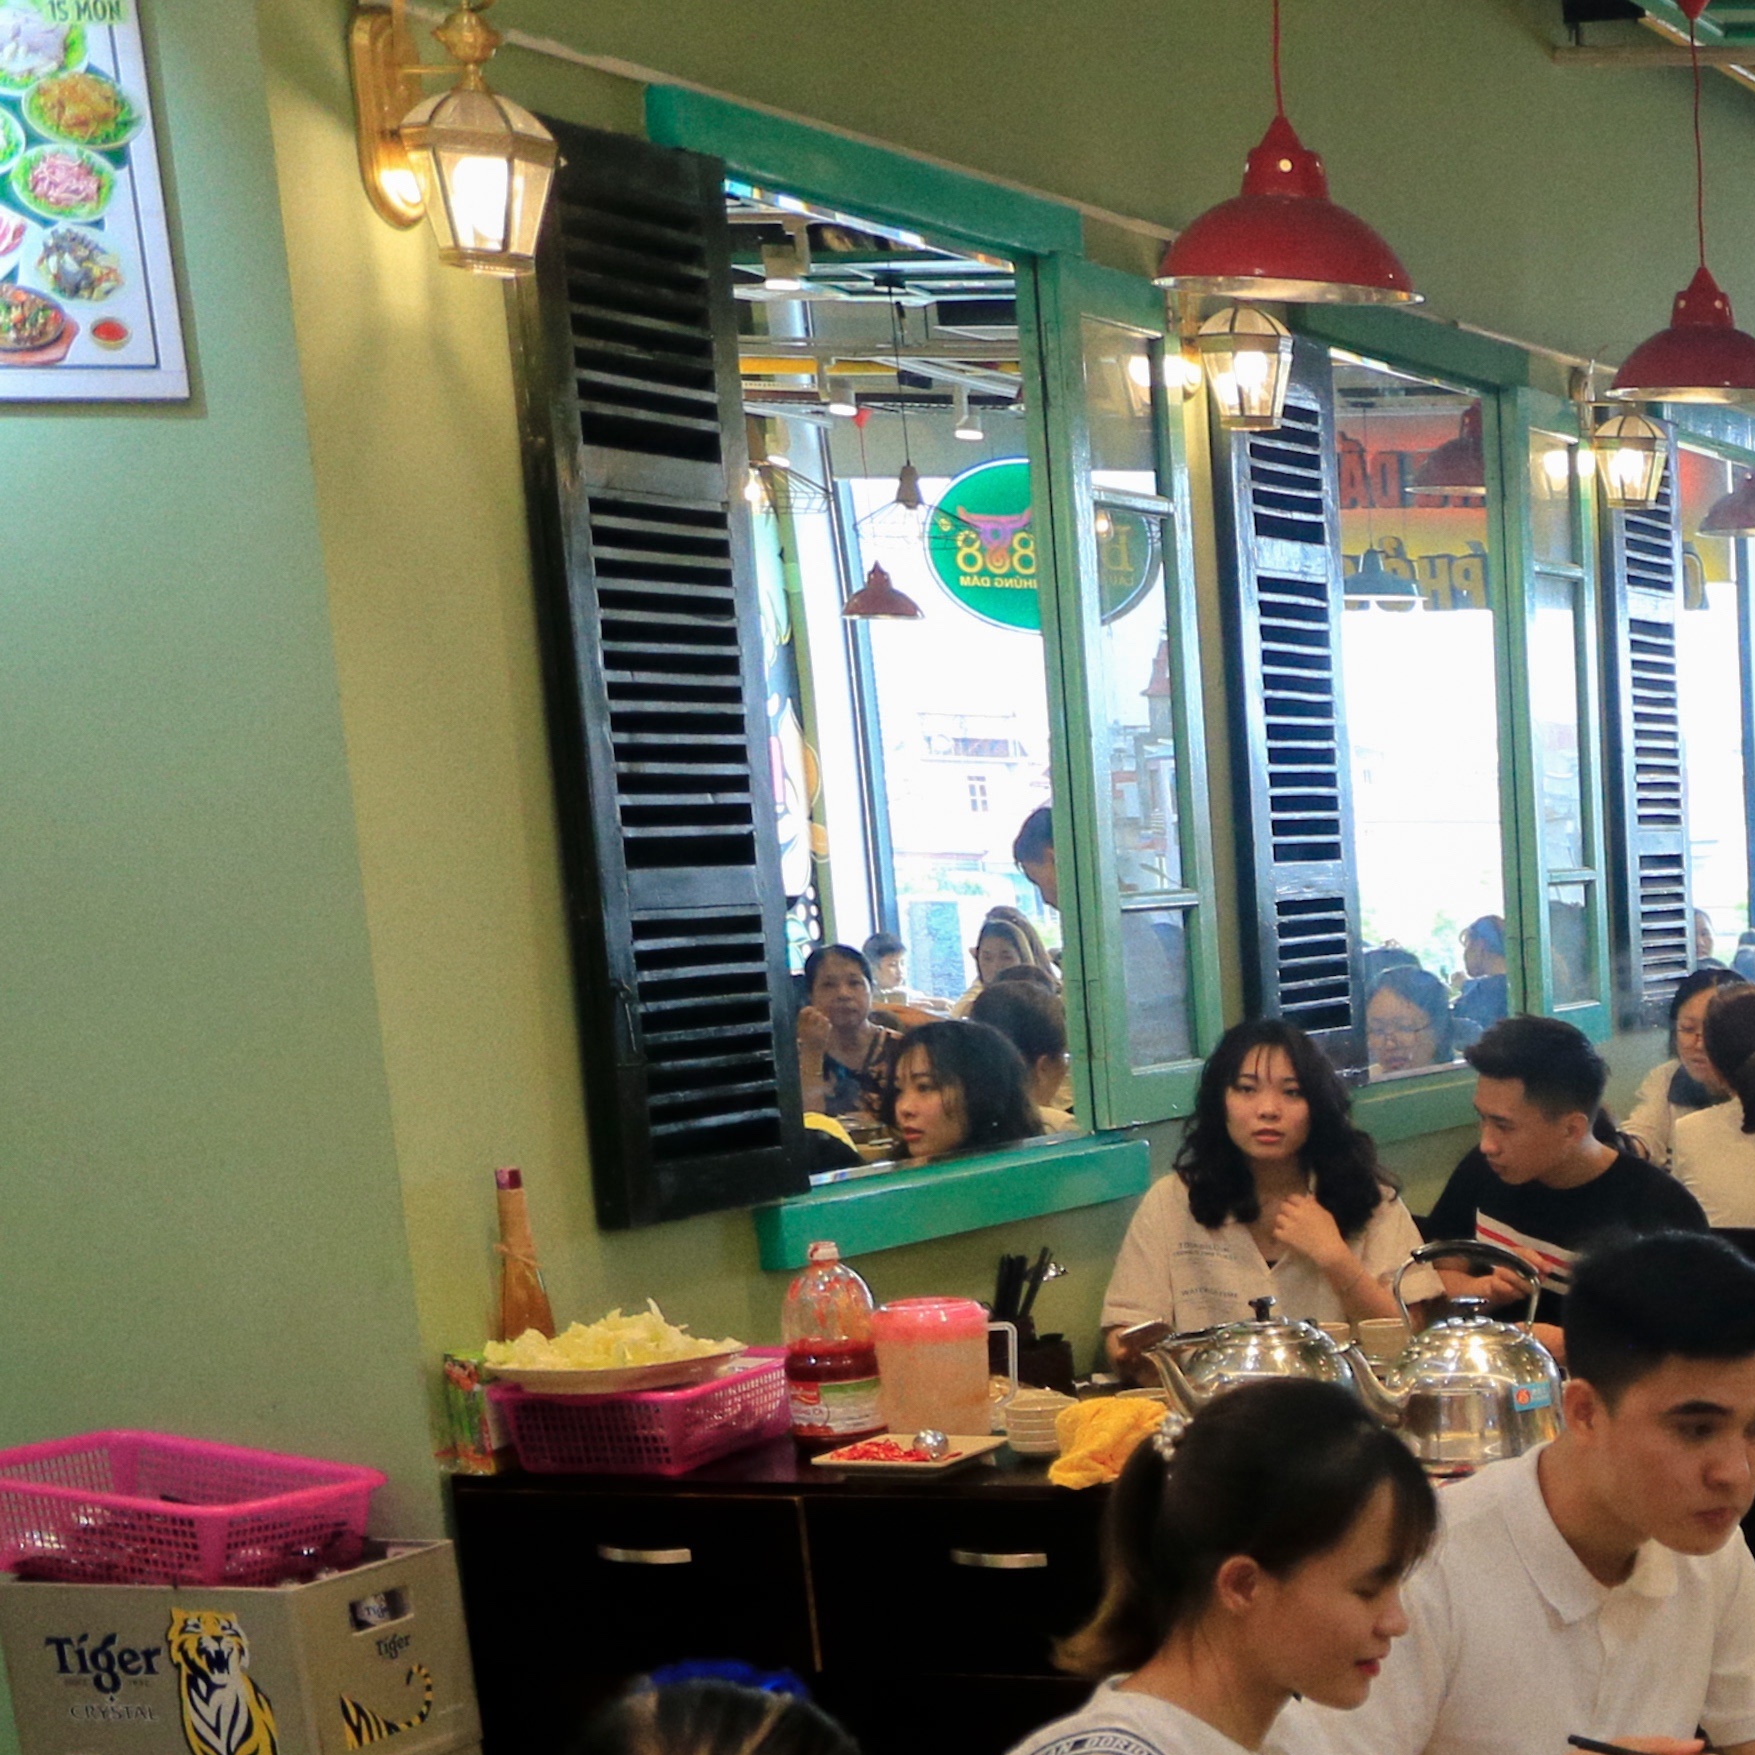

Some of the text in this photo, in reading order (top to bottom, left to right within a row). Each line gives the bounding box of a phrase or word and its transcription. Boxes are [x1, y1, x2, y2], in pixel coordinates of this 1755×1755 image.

[375, 1632, 412, 1658] Tiger
[45, 1632, 162, 1694] Tiger
[70, 1703, 160, 1721] CRYSTAL
